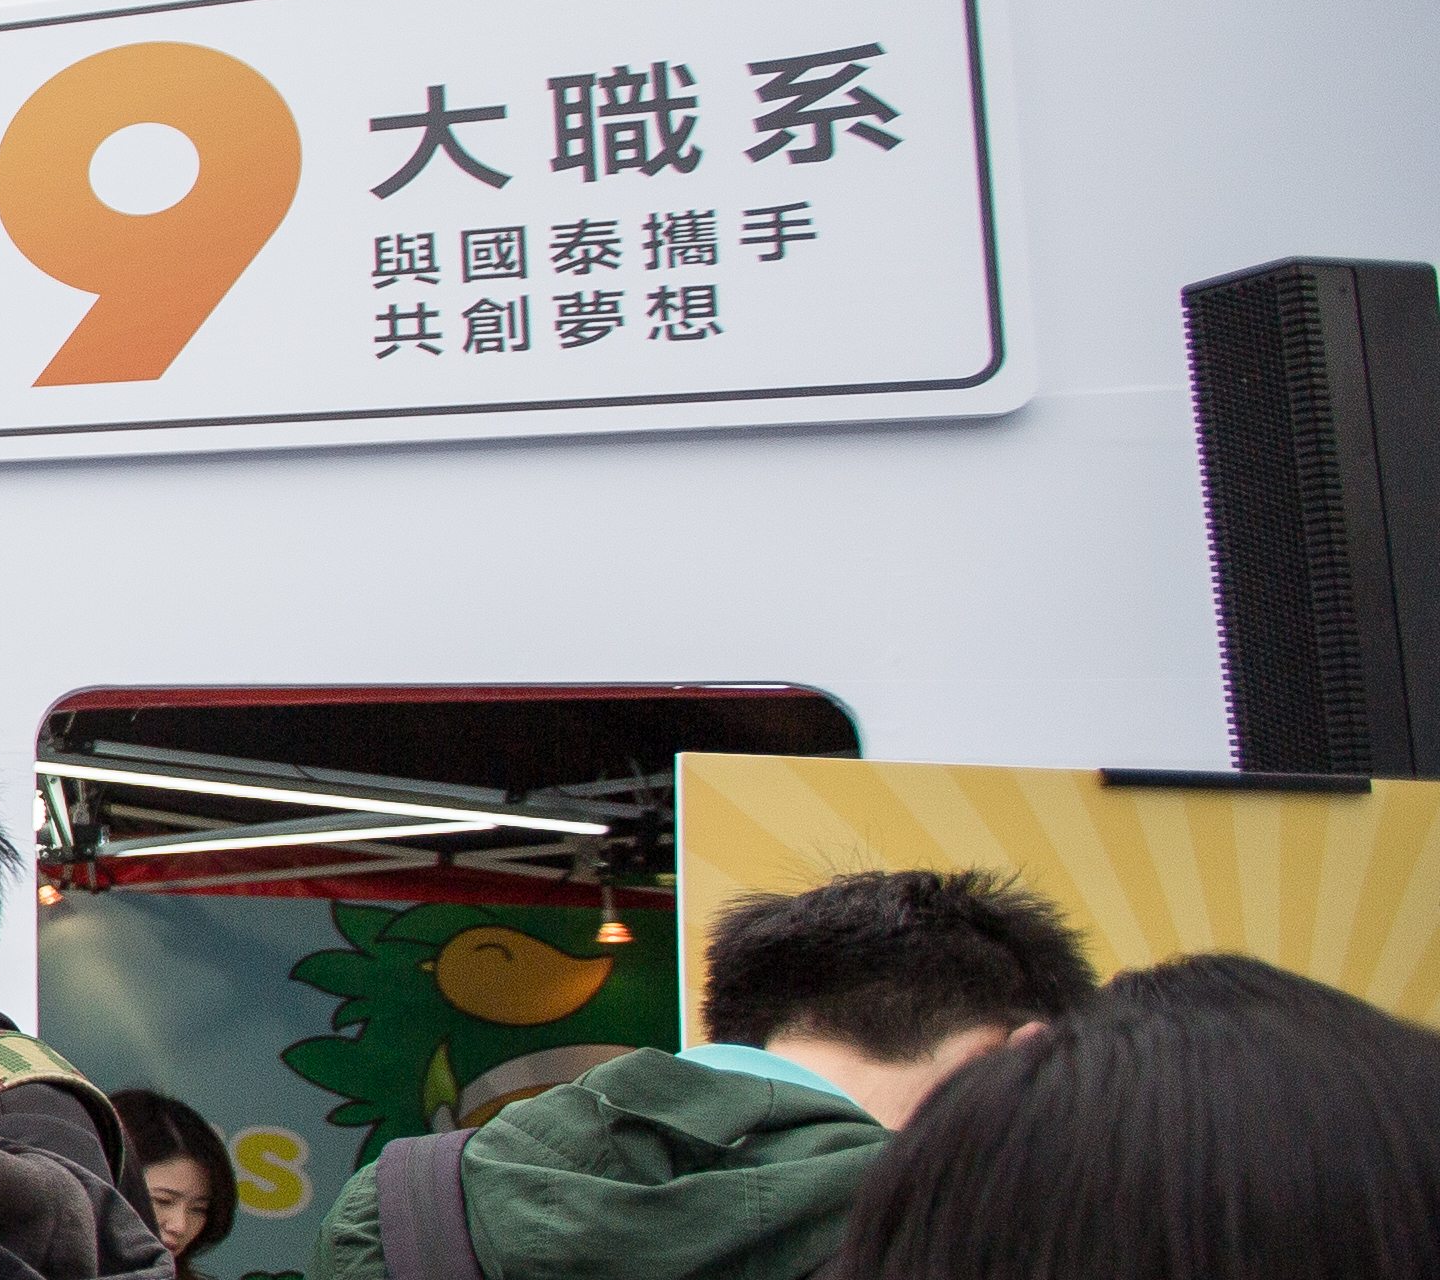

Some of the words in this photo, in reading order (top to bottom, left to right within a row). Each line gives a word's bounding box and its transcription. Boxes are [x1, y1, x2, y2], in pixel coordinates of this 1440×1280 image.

[368, 41, 906, 201] 大職系
[370, 200, 818, 290] 與國泰攜手
[373, 282, 725, 361] 共創夢想
